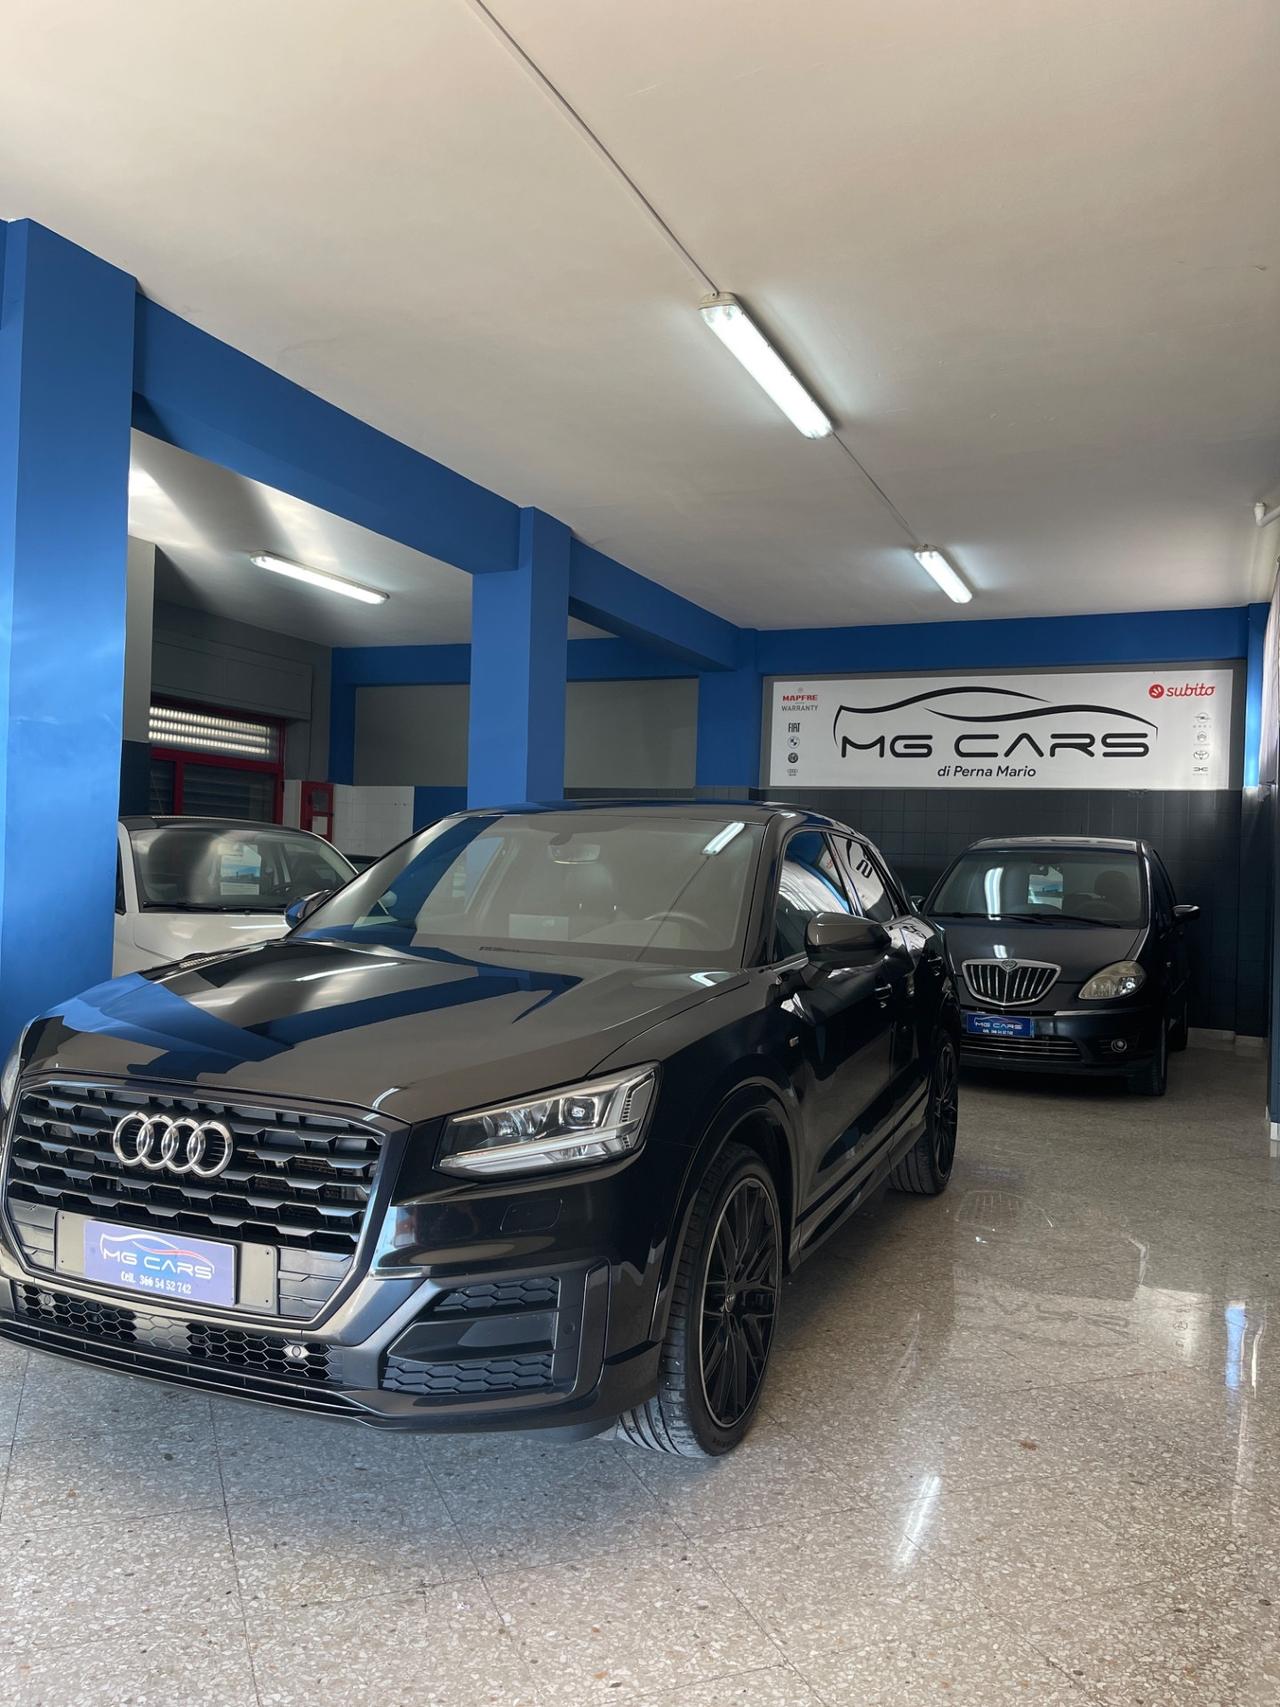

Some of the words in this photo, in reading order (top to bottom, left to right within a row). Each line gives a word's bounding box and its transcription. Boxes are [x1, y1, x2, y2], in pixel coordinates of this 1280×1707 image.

[1166, 683, 1216, 697] subito
[783, 694, 818, 702] MAPFRE
[781, 704, 818, 712] WARRANTY
[788, 722, 800, 733] FIAT
[841, 734, 933, 758] MG
[954, 732, 1149, 758] CARS
[937, 765, 950, 777] di
[953, 765, 992, 777] Perna
[996, 765, 1036, 778] Mario
[103, 1249, 138, 1266] MG
[143, 1257, 213, 1280] CARS
[139, 1274, 153, 1287] 366
[154, 1277, 165, 1289] 54
[165, 1279, 176, 1291] 52
[177, 1281, 192, 1295] 742
